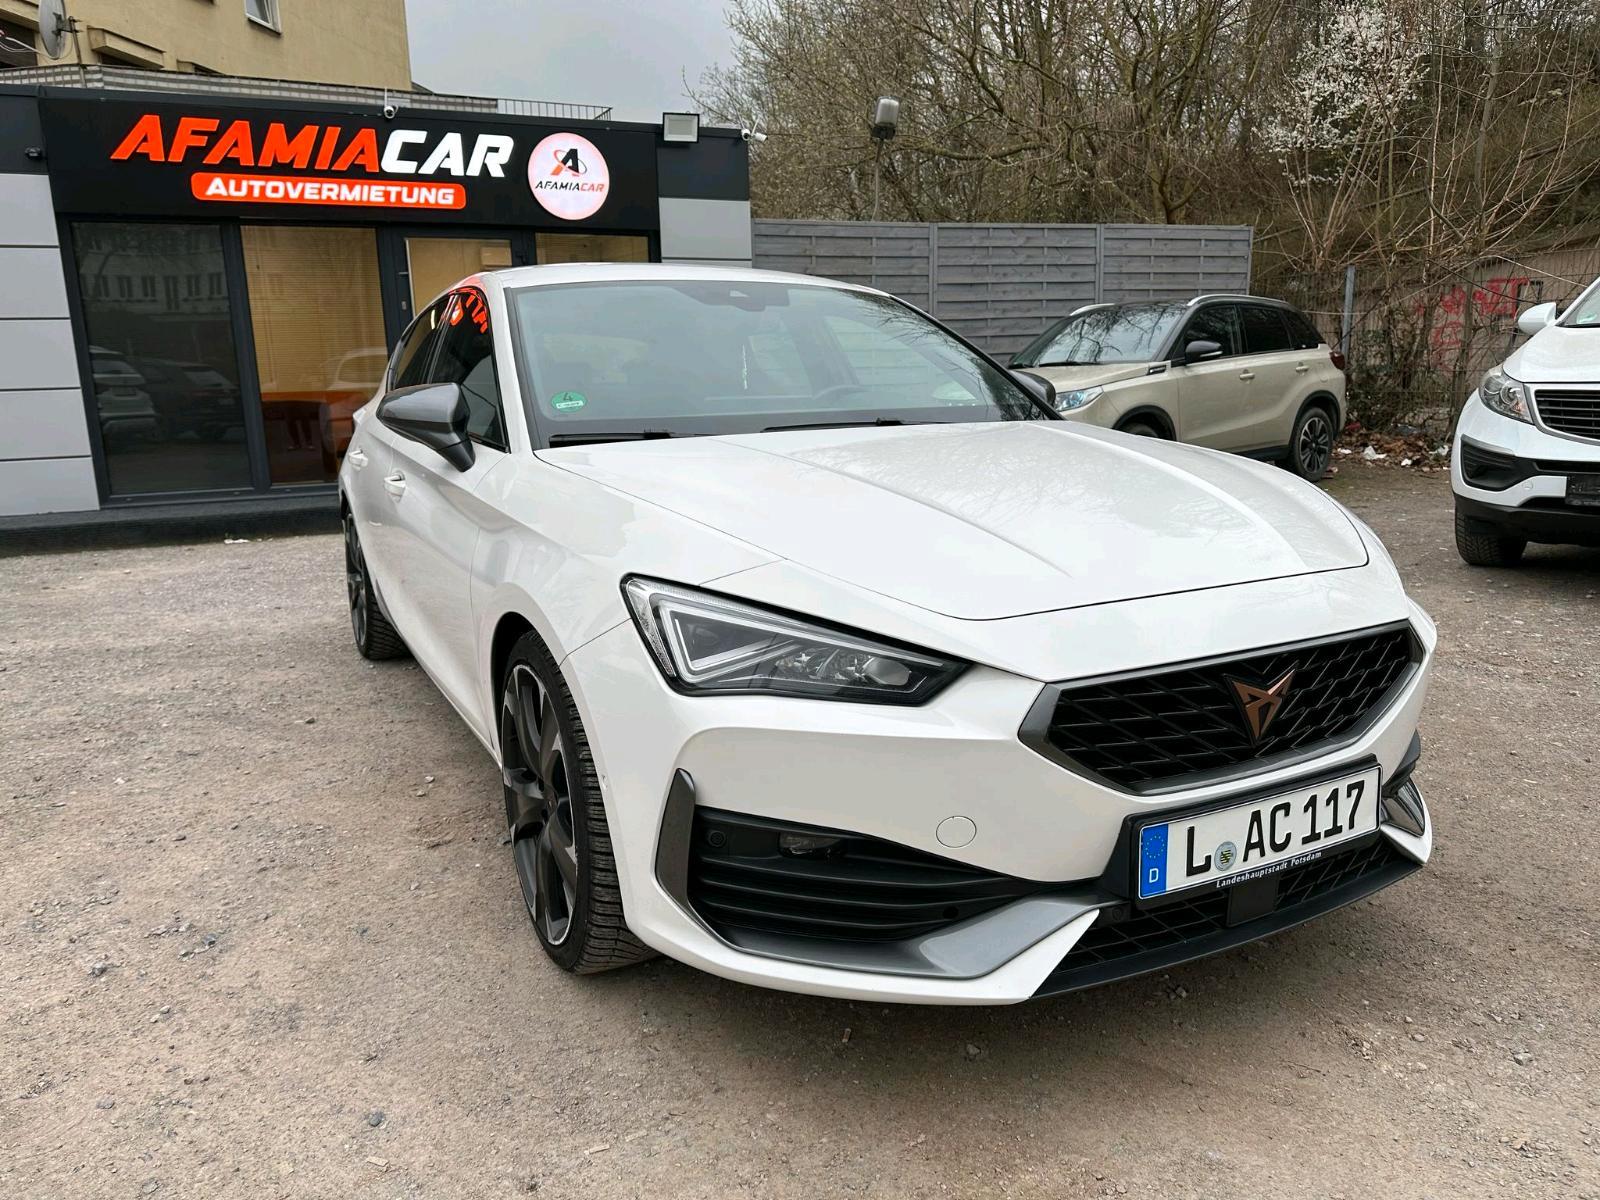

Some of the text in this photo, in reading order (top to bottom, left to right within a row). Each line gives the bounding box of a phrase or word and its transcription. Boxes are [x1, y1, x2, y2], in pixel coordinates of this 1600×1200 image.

[110, 114, 515, 178] AFAMIACAR
[205, 176, 455, 205] AUTOVERMIETUNG
[535, 180, 605, 193] AFAMIACAR
[1186, 779, 1365, 877] L AC 117
[1149, 868, 1159, 883] D
[1216, 851, 1322, 889] Landeshauptstadt Potsdam
